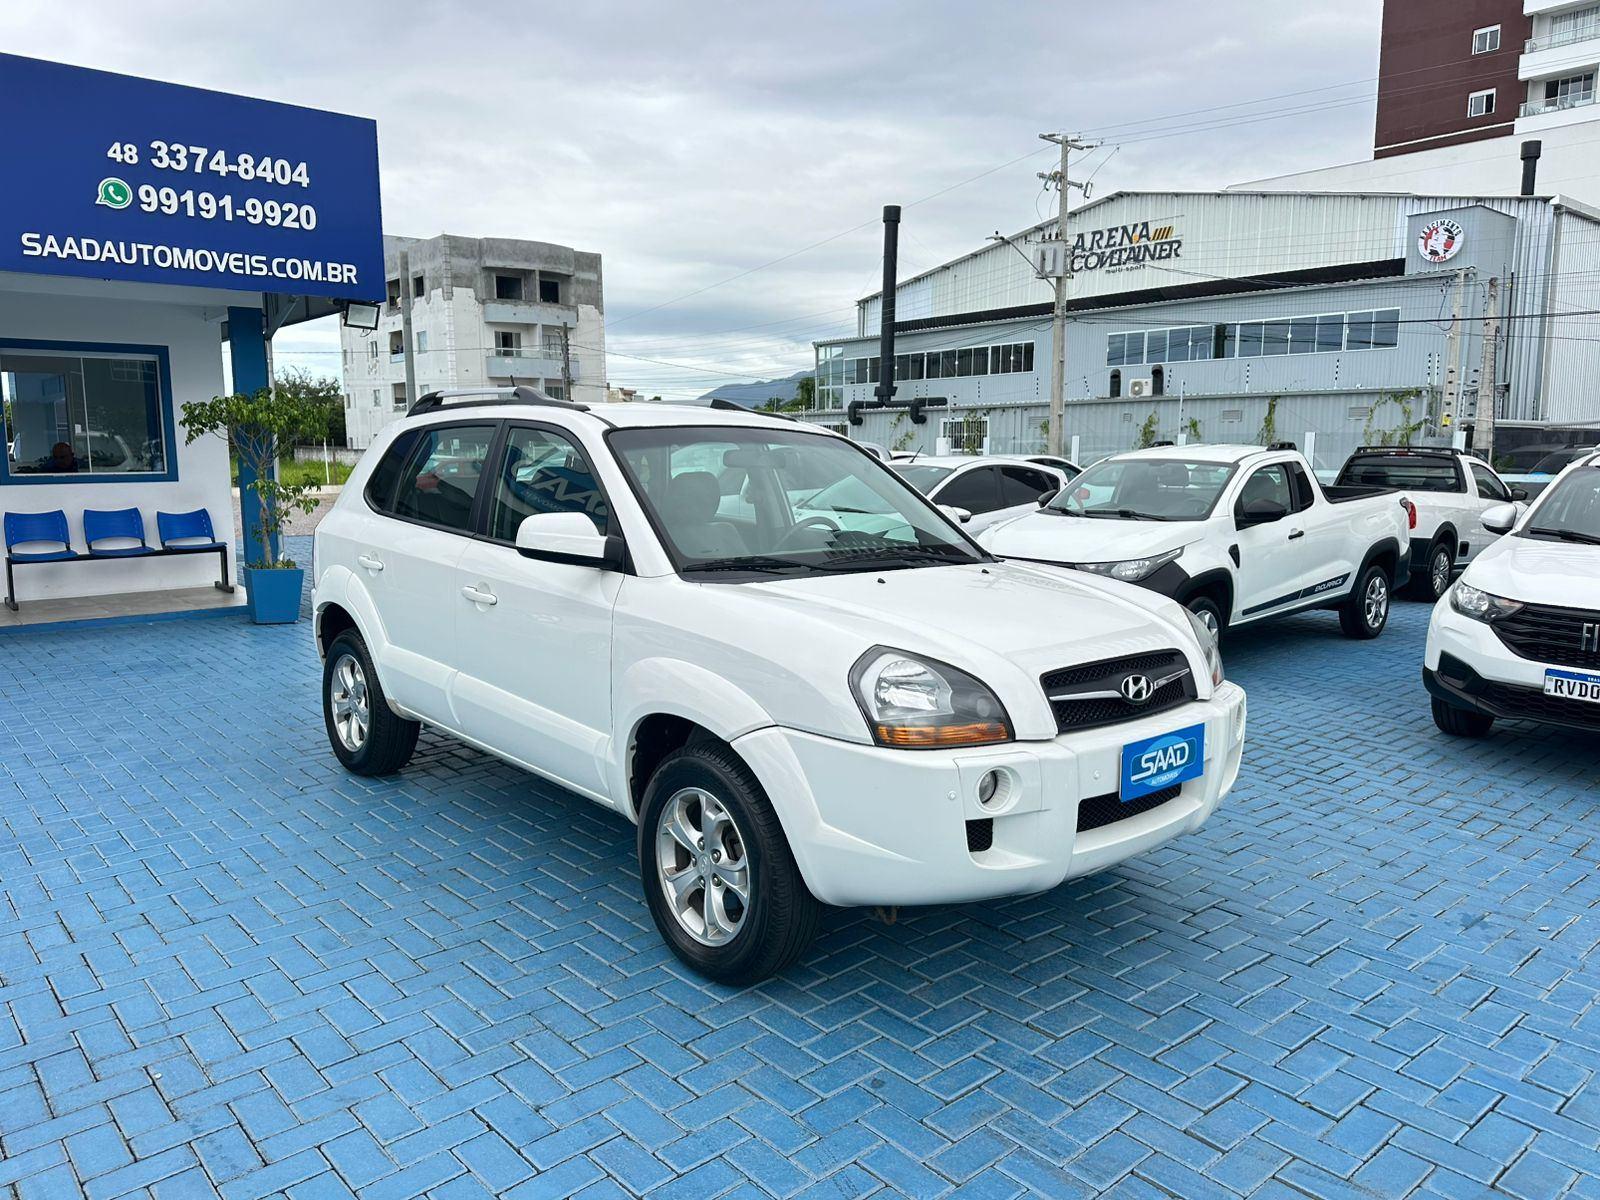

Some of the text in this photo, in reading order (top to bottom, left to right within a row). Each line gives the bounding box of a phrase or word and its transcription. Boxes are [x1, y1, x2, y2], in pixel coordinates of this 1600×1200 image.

[107, 140, 310, 188] 48 3374-8404
[138, 184, 317, 231] 99191-9920
[21, 232, 358, 285] SAADAUTOMOVEIS.COM.BR
[1071, 239, 1182, 273] CONTAINER
[1073, 221, 1152, 252] ARENA
[1131, 741, 1190, 782] SAAD
